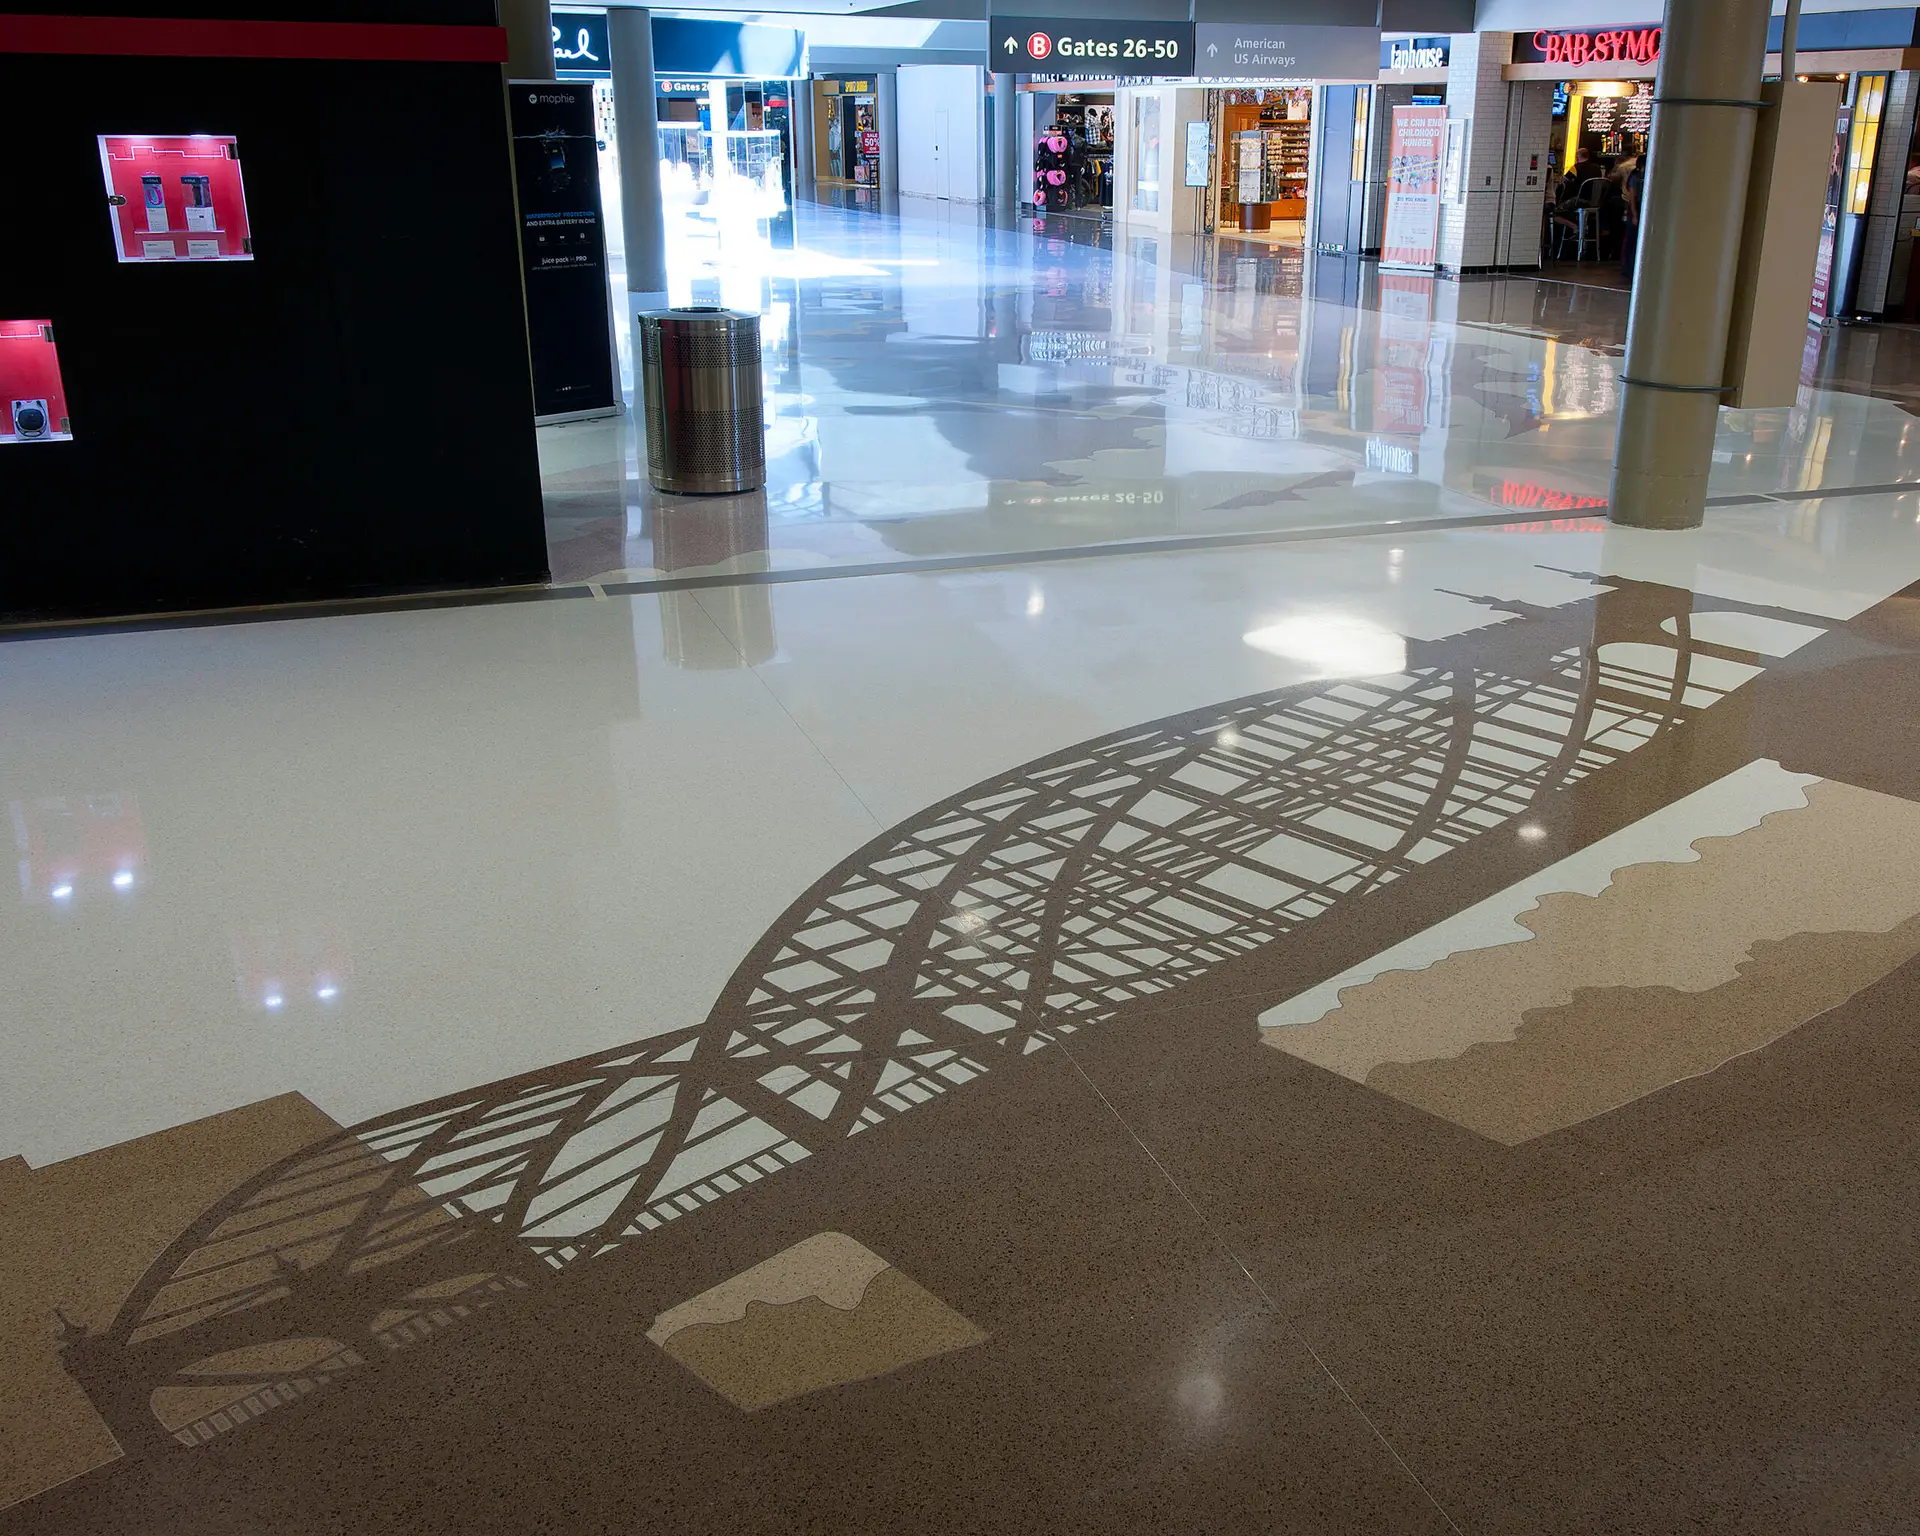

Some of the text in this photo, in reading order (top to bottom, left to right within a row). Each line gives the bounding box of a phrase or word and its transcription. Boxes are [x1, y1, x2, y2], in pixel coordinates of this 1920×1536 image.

[1033, 37, 1178, 59] B Gates 26-50
[1234, 38, 1285, 49] American
[1533, 30, 1594, 68] BAR
[1234, 53, 1296, 67] US Airways
[1390, 39, 1443, 75] taphouse
[674, 83, 700, 92] Gates
[540, 93, 575, 105] mophie
[1397, 119, 1442, 127] WE CAN END
[1398, 128, 1440, 137] CHILDHOOD
[1402, 138, 1433, 147] HUNGER.
[555, 255, 569, 264] pack
